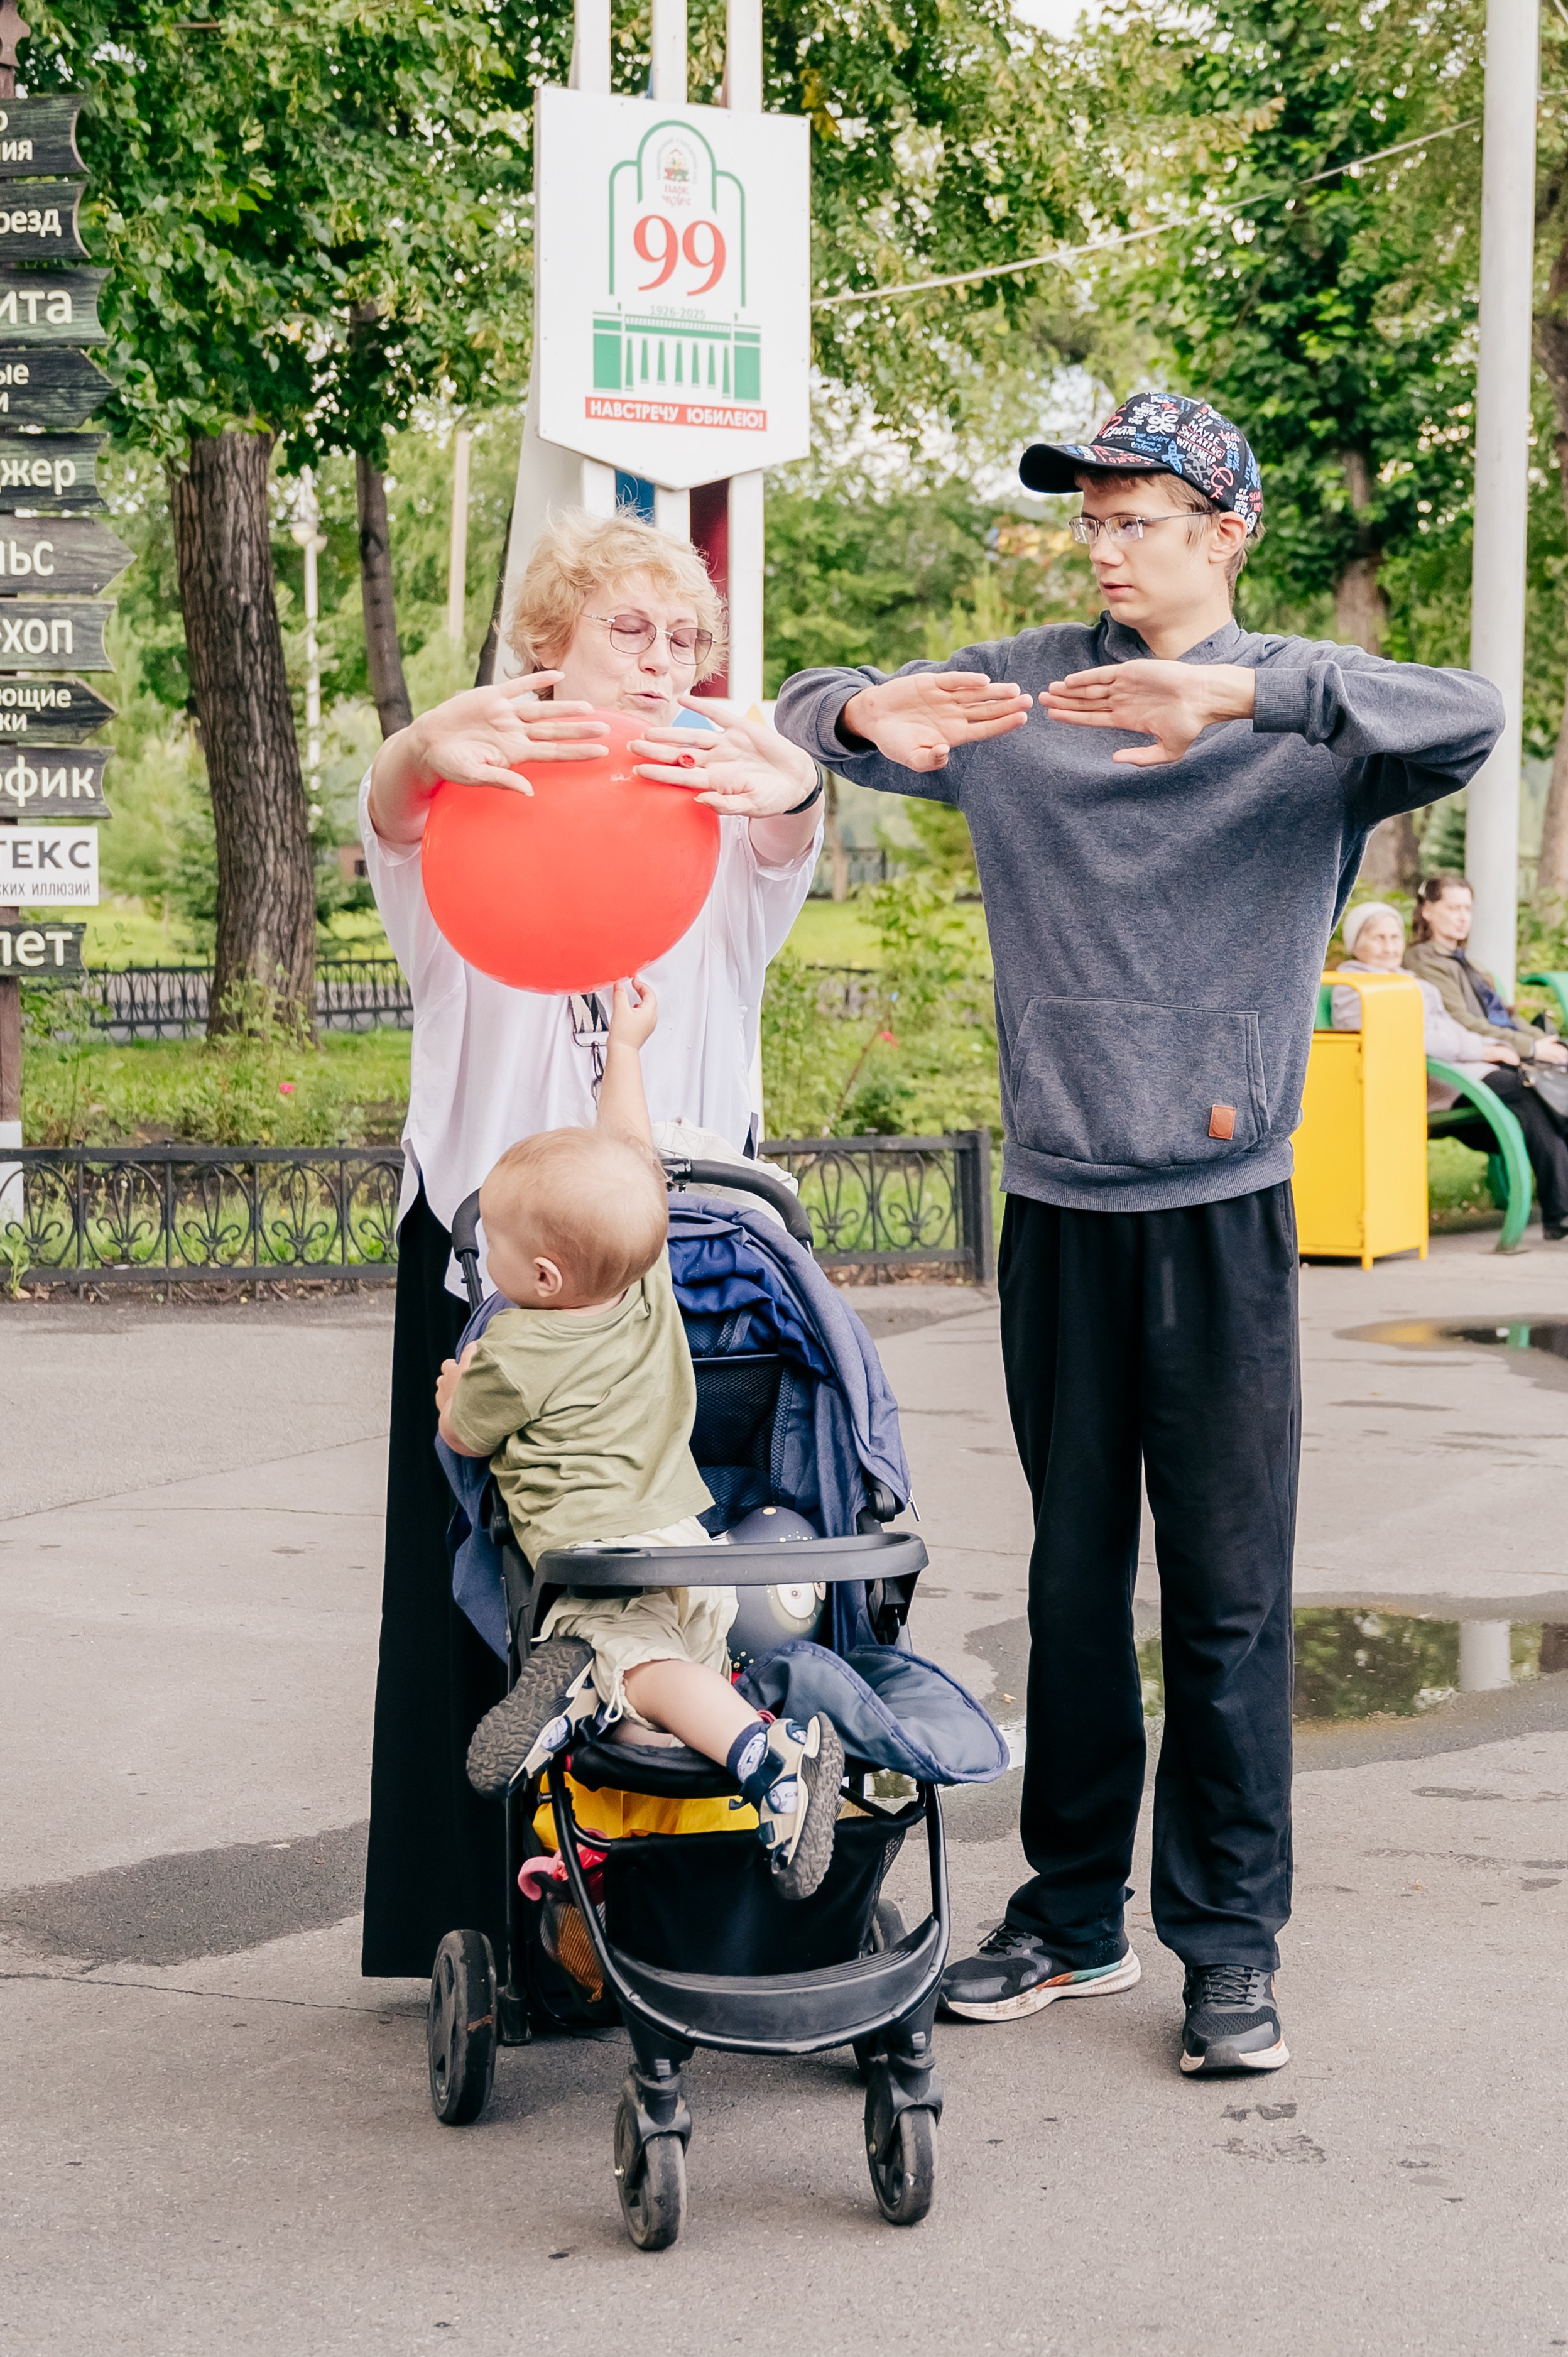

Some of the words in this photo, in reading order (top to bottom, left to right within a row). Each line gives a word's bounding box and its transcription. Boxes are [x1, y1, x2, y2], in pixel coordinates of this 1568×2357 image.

[0, 139, 33, 161] ия
[633, 214, 727, 297] 99
[650, 305, 706, 320] 1926-2025
[590, 400, 679, 422] НАВСТРЕЧУ
[687, 406, 763, 428] ЮБИЛЕЮ!
[1179, 426, 1222, 457] SWEARING
[1188, 420, 1220, 445] MAYBE
[0, 459, 75, 496] жер
[0, 618, 73, 654] ХОП
[0, 754, 95, 808] фик
[0, 883, 25, 896] КИХ
[32, 881, 90, 896] ИЛЛЮЗИЙ
